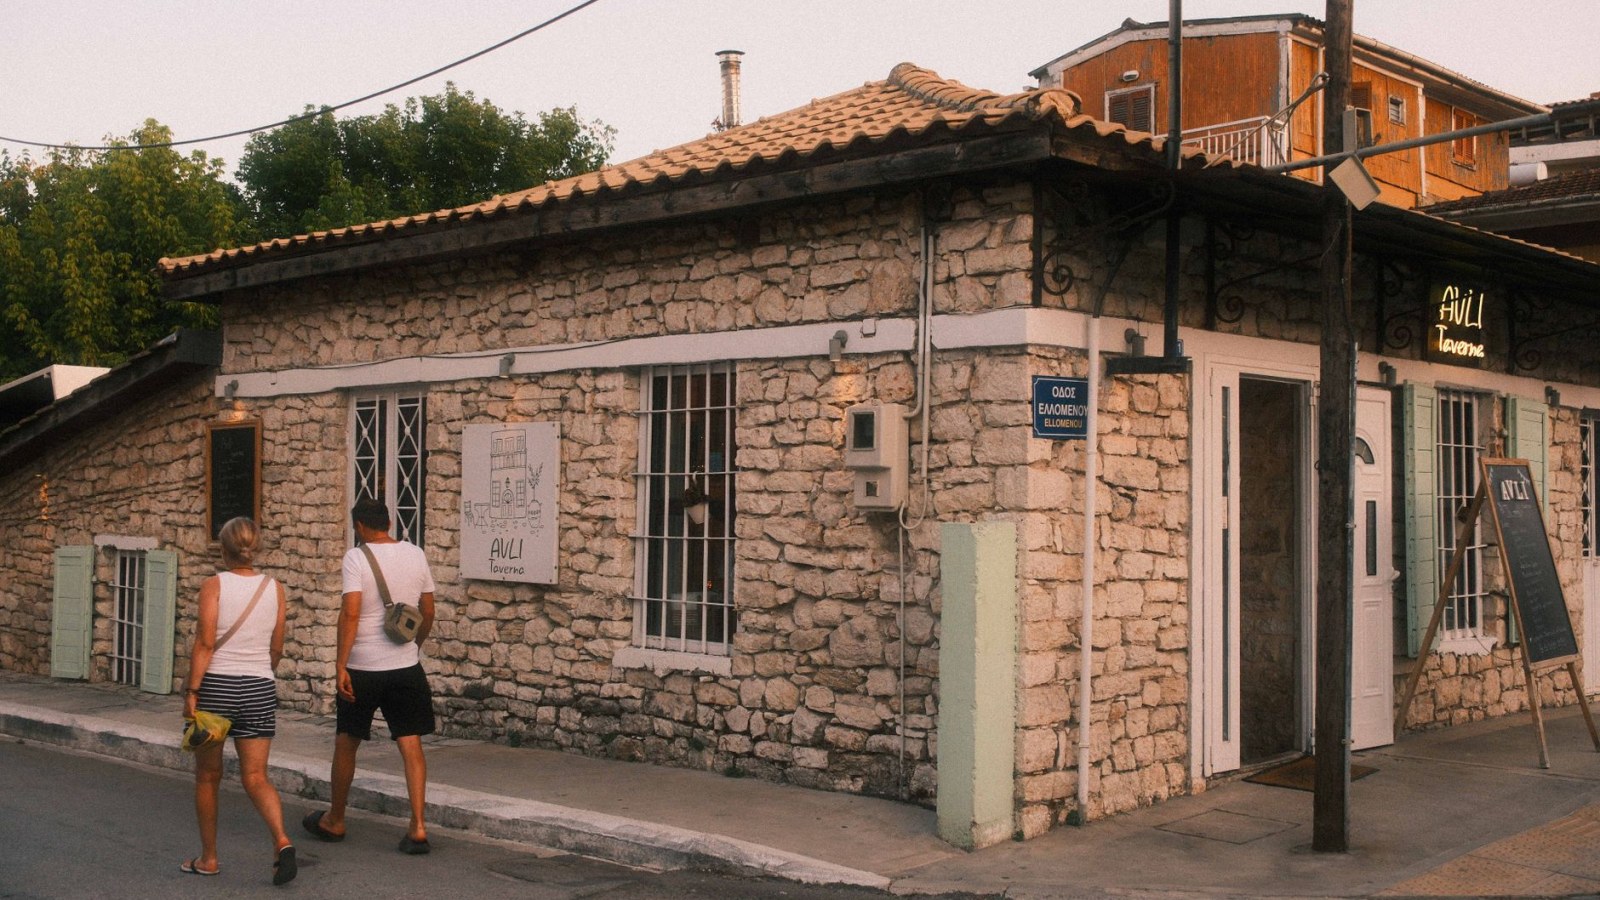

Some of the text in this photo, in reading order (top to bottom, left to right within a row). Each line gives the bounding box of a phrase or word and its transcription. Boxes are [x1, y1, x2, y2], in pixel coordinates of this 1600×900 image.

[1439, 285, 1484, 330] AVLI
[1435, 324, 1485, 358] Taverna
[1052, 386, 1076, 399] ΟΔΟΣ
[1038, 402, 1089, 417] ΕΛΛΟΜΕΝΟΥ
[1044, 418, 1083, 429] ELLOMENOU
[1501, 479, 1530, 501] AVLI
[490, 537, 523, 560] AVLI
[488, 558, 525, 575] Taverna
